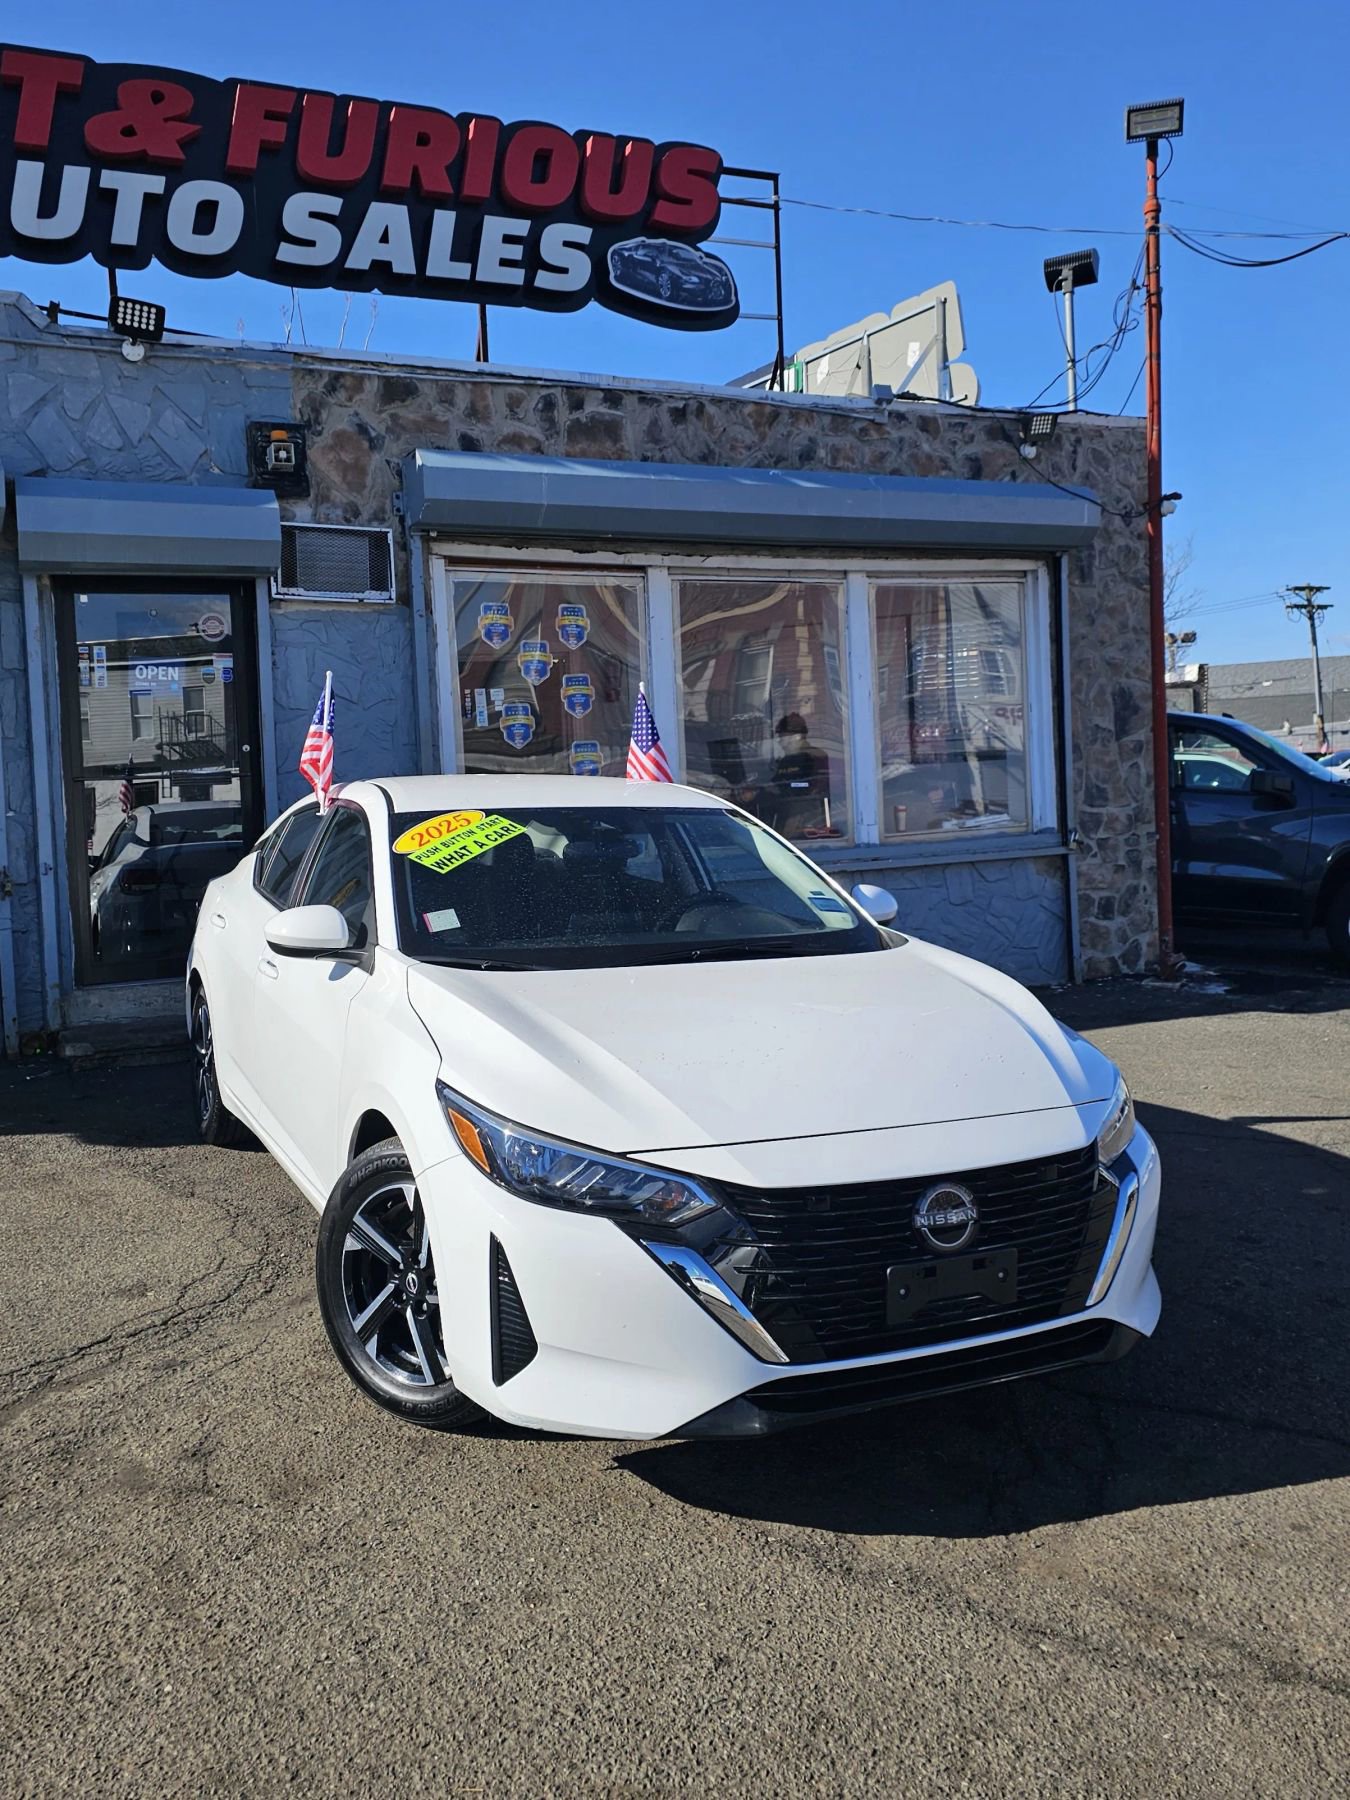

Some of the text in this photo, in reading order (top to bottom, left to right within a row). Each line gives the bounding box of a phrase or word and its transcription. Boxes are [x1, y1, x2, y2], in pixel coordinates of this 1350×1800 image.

[84, 79, 202, 164] &
[226, 83, 721, 230] FURIOUS
[9, 159, 593, 292] UTO SALES
[135, 664, 179, 681] OPEN
[410, 814, 472, 848] 2025
[415, 816, 504, 862] PUSH BUTTON START
[430, 823, 521, 871] WHAT A CAR!
[916, 1208, 977, 1227] NISSAN
